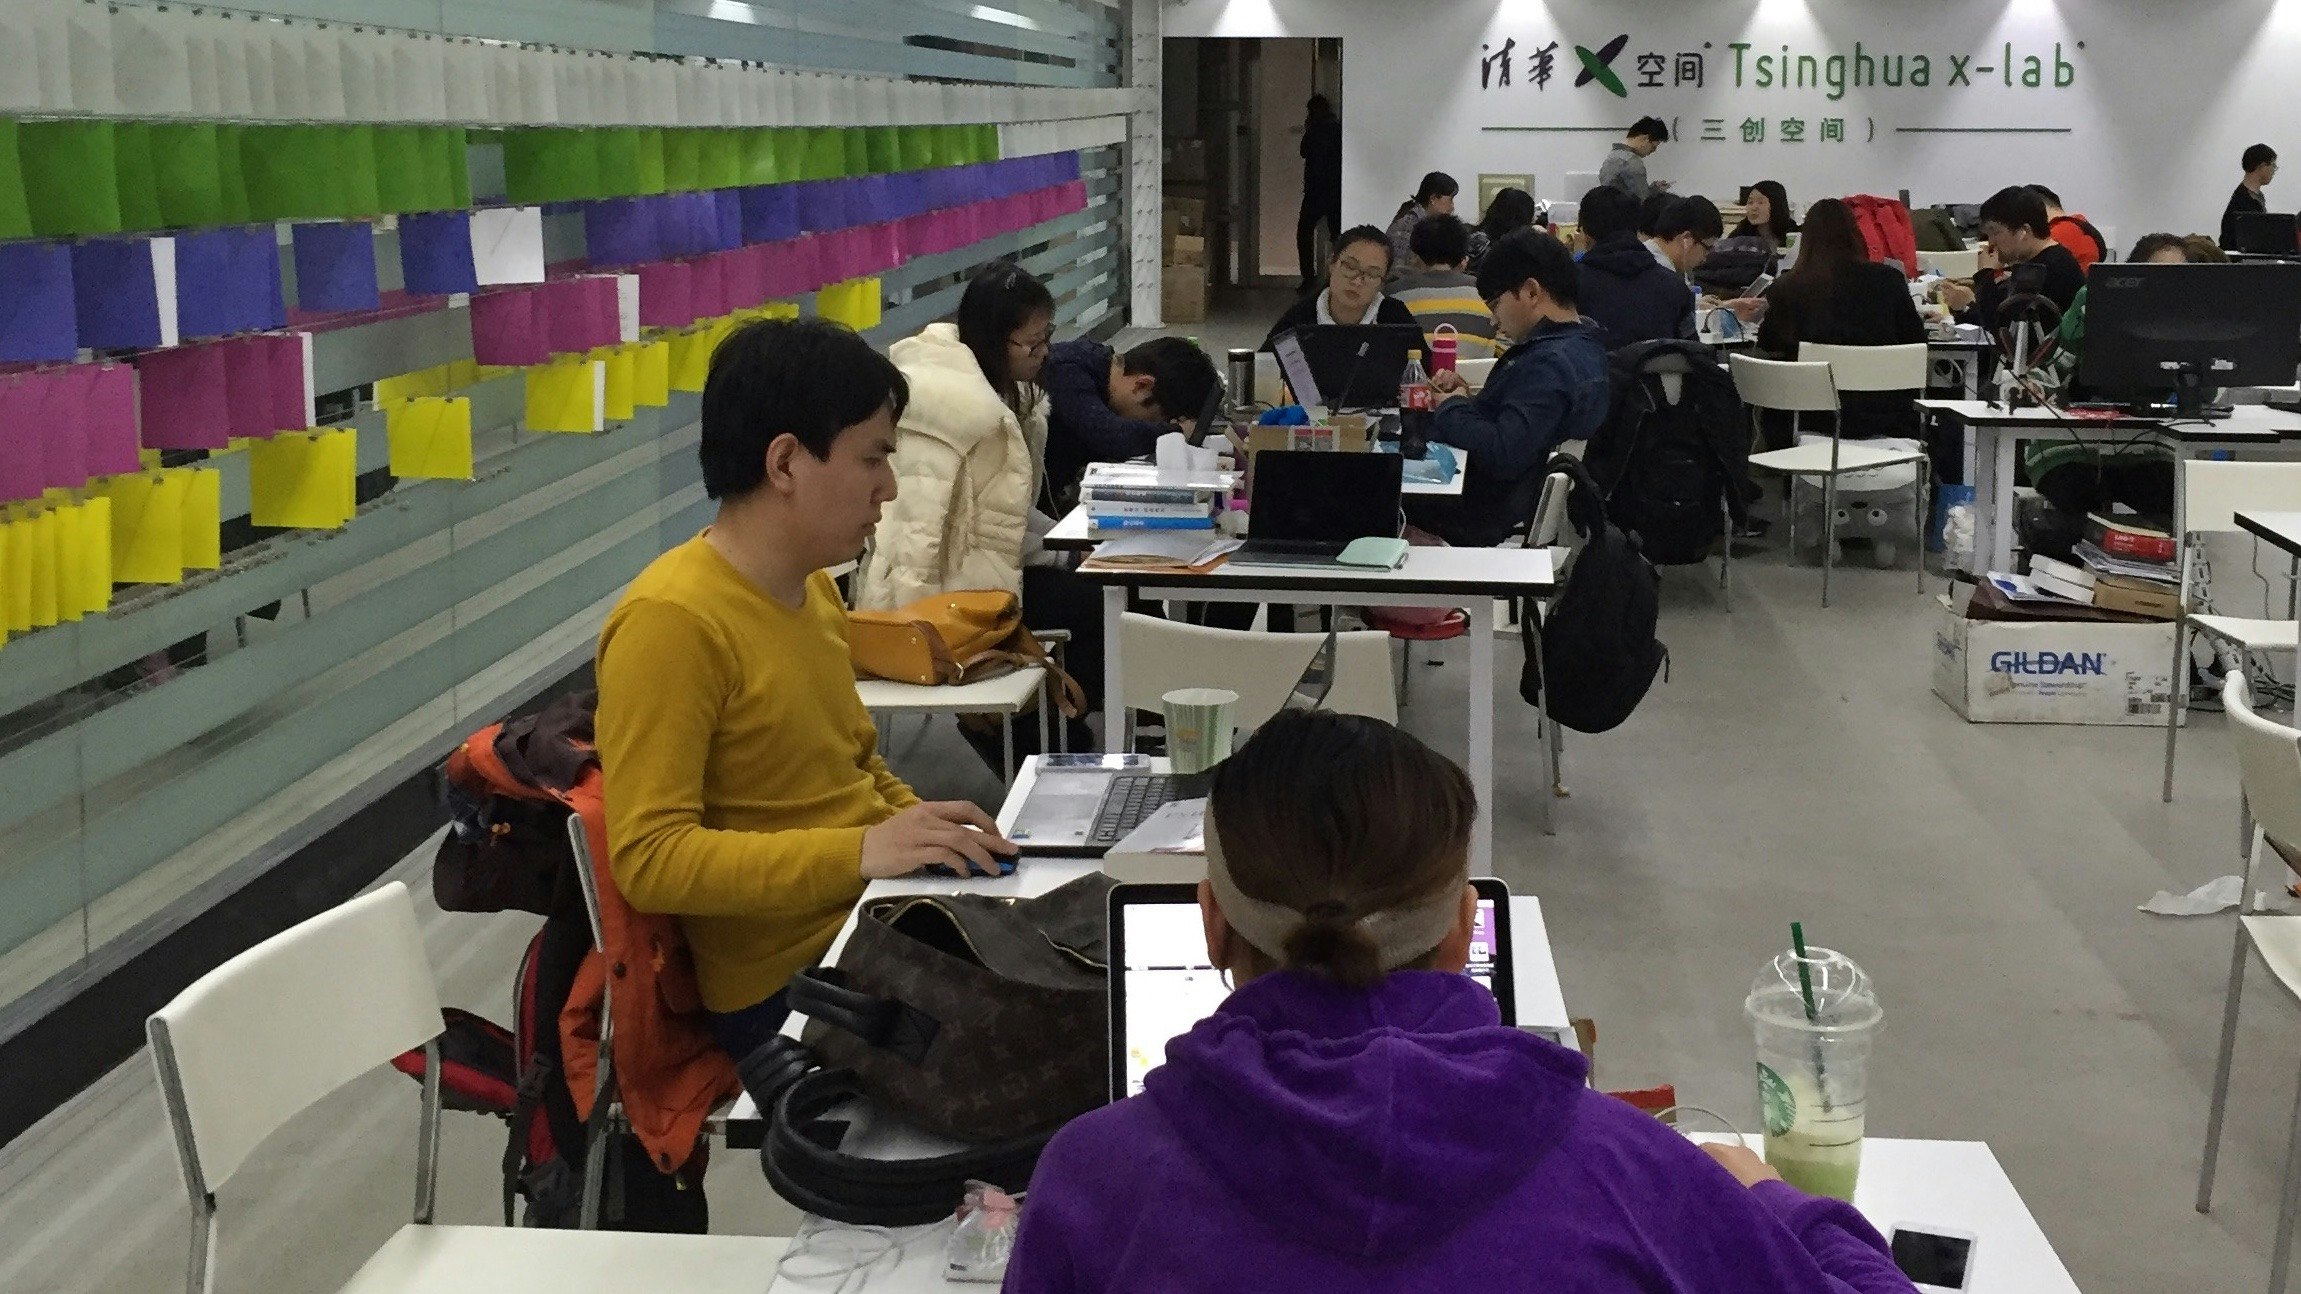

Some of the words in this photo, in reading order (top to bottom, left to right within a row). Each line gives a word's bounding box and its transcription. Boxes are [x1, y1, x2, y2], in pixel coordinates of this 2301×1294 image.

[1637, 52, 1704, 89] 空间
[1728, 41, 1931, 100] Tsinghua
[1948, 41, 2075, 88] x-lab
[1990, 651, 2106, 675] GILDAN
